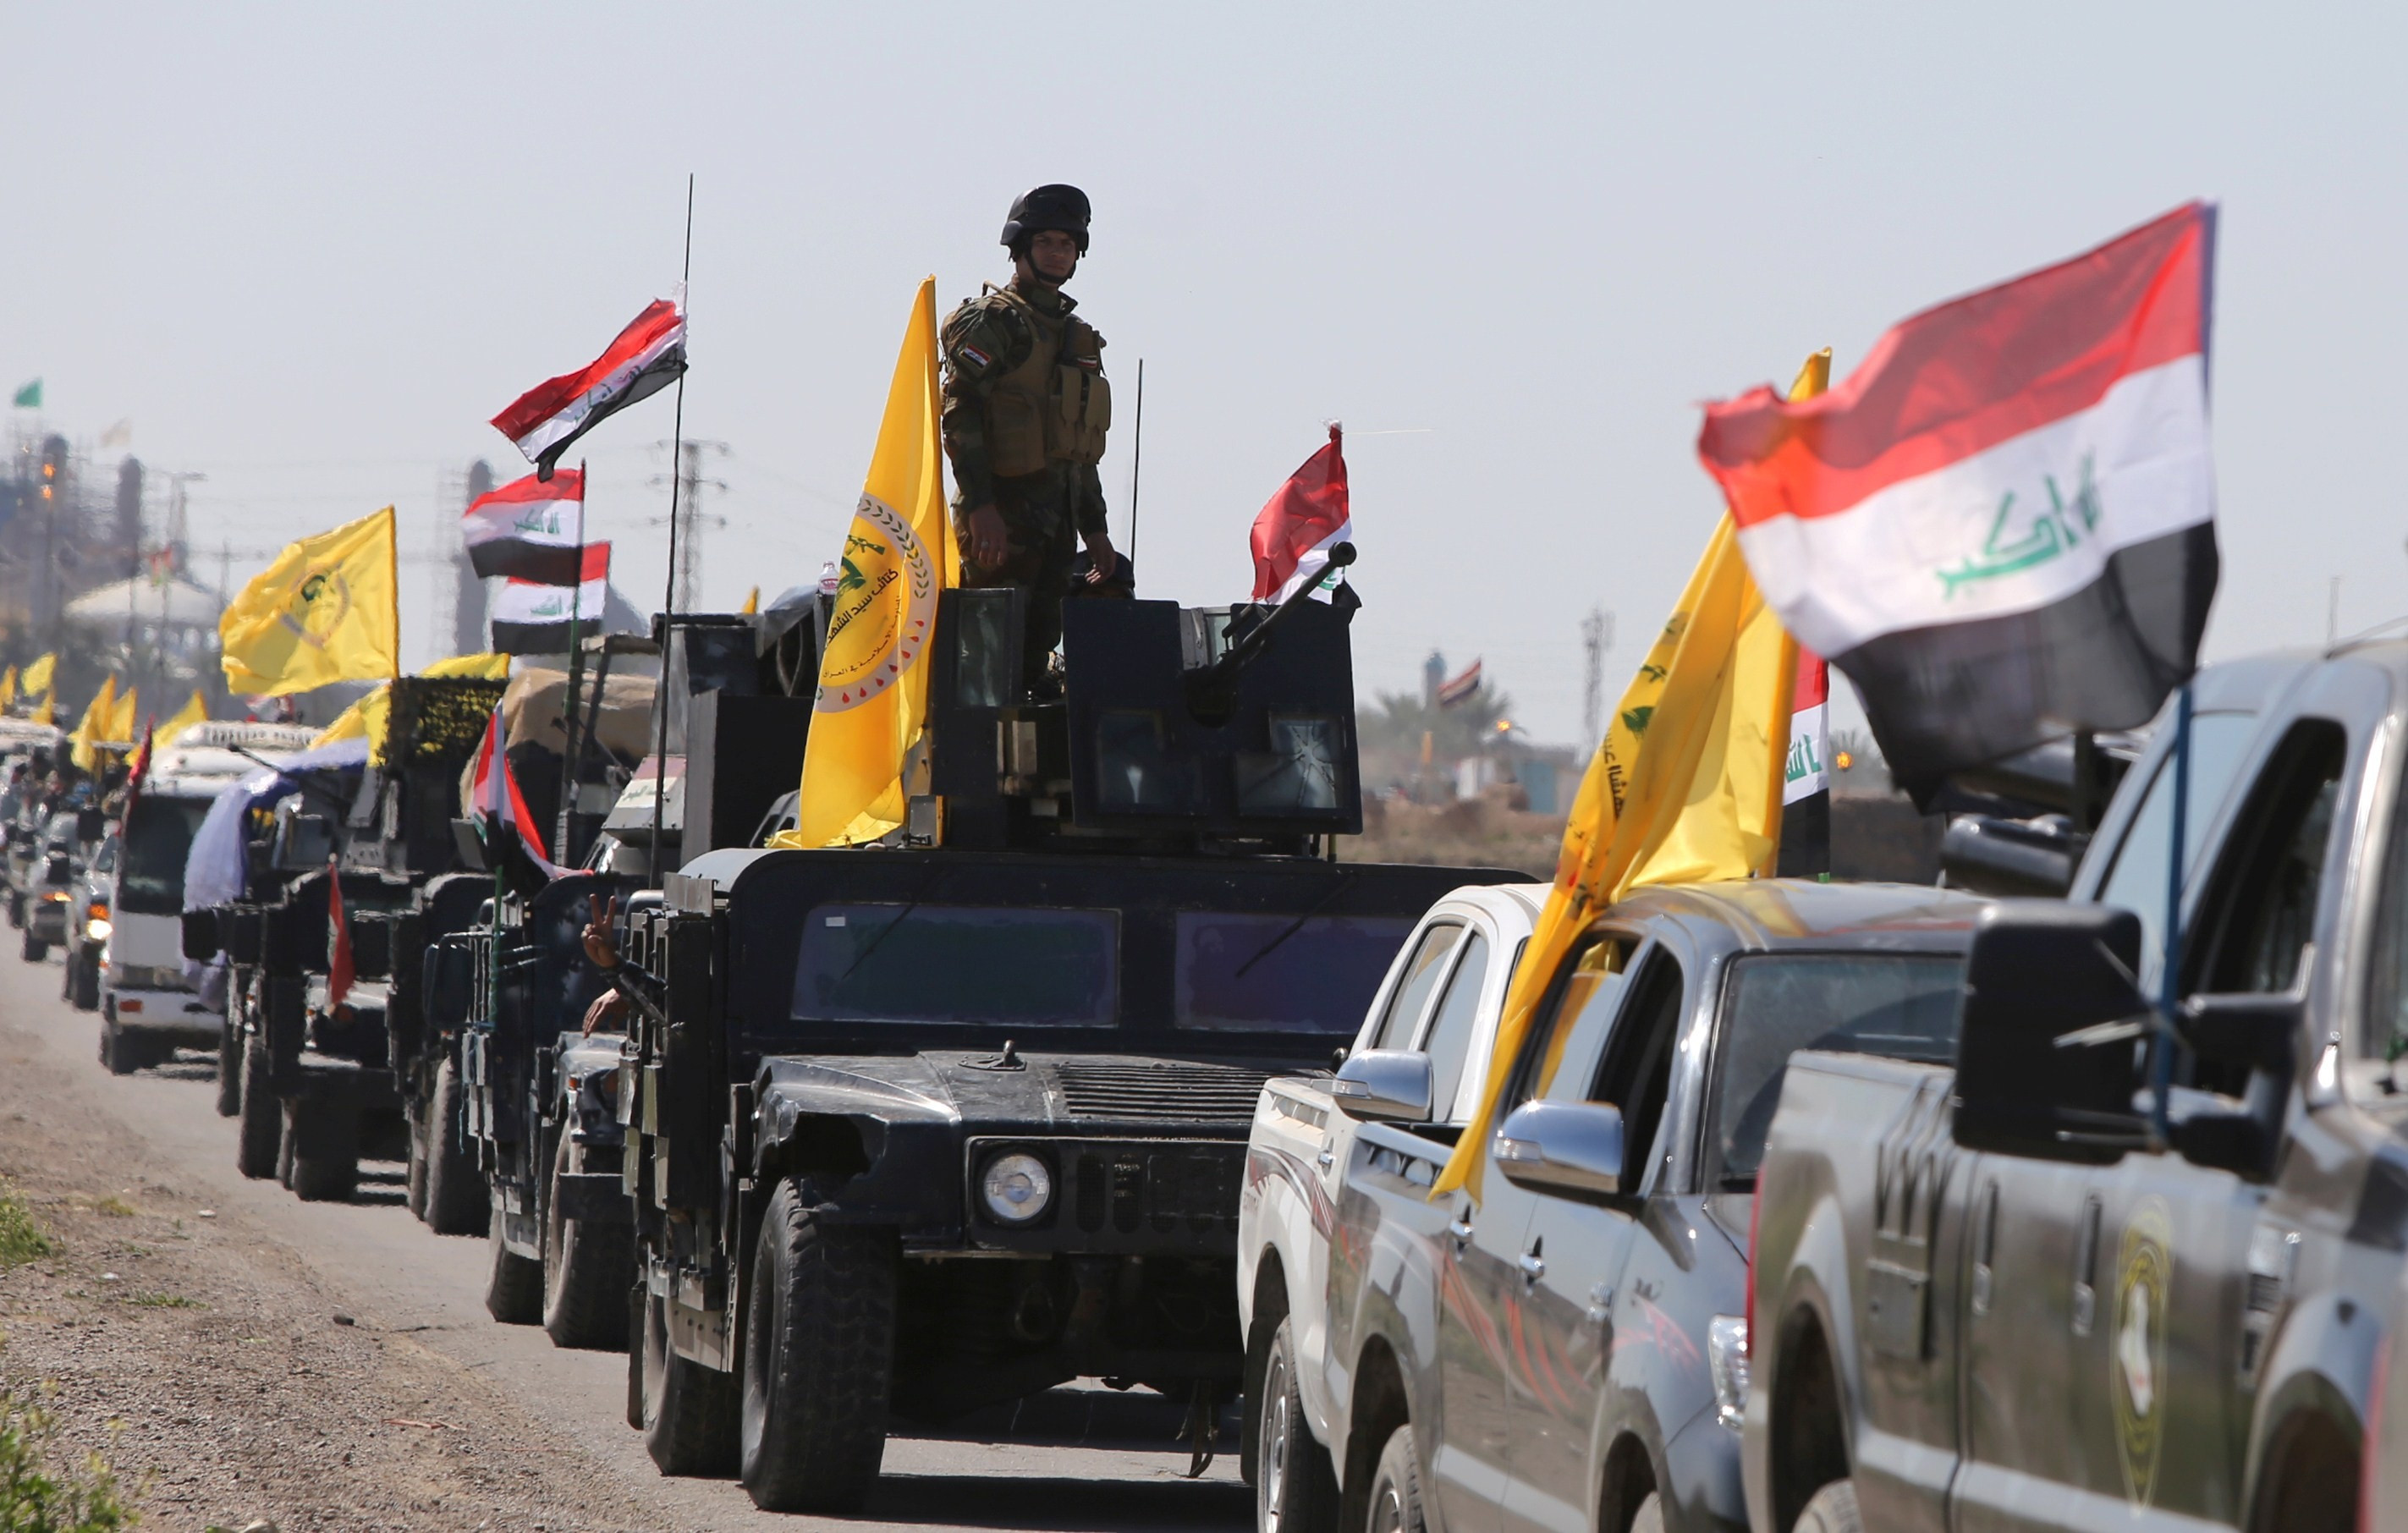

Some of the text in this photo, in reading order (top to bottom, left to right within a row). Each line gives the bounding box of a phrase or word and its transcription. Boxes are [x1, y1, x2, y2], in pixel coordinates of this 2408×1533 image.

[871, 568, 899, 596] كتائب
[851, 594, 873, 616] سيد
[826, 610, 853, 646] الشهد
